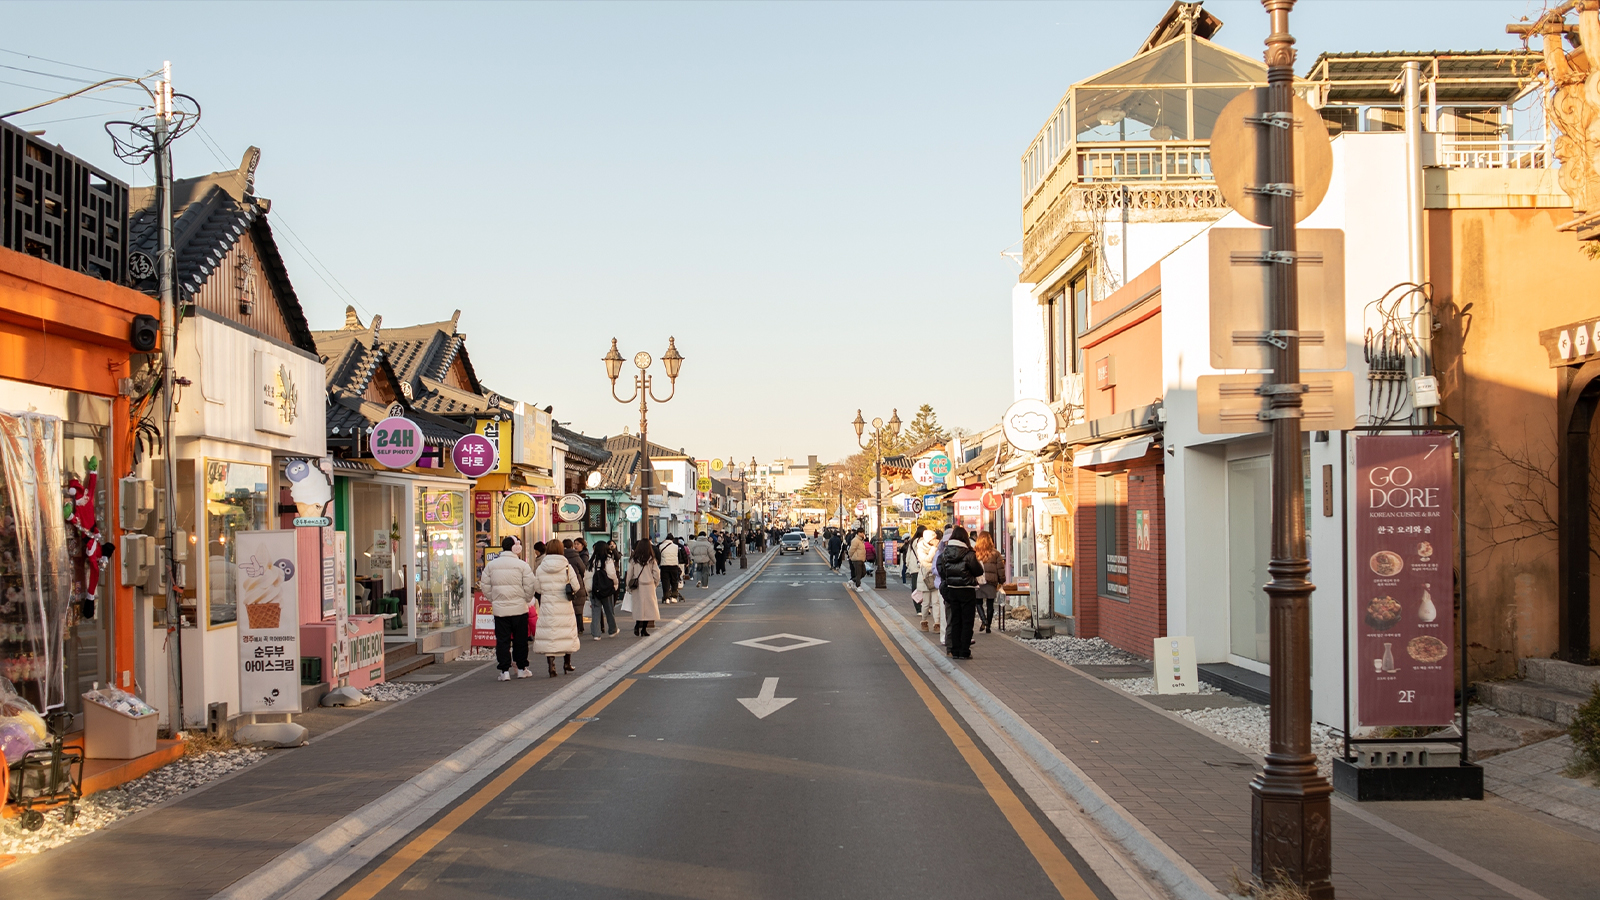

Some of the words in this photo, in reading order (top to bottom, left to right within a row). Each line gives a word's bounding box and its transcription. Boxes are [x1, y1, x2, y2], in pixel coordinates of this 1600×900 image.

[377, 429, 414, 447] 24H
[461, 443, 485, 455] 사주
[461, 456, 485, 467] 타로
[932, 458, 948, 466] 사주
[1369, 466, 1412, 487] GO
[1369, 488, 1440, 508] DORE
[517, 501, 530, 518] 10
[1377, 526, 1394, 534] 한국
[1397, 525, 1421, 534] 요리와
[1424, 526, 1432, 534] 술
[242, 635, 262, 643] 경주에서
[254, 646, 285, 658] 순두부
[358, 637, 371, 661] THE
[245, 659, 295, 672] 아이스크림
[1398, 690, 1415, 703] 2F
